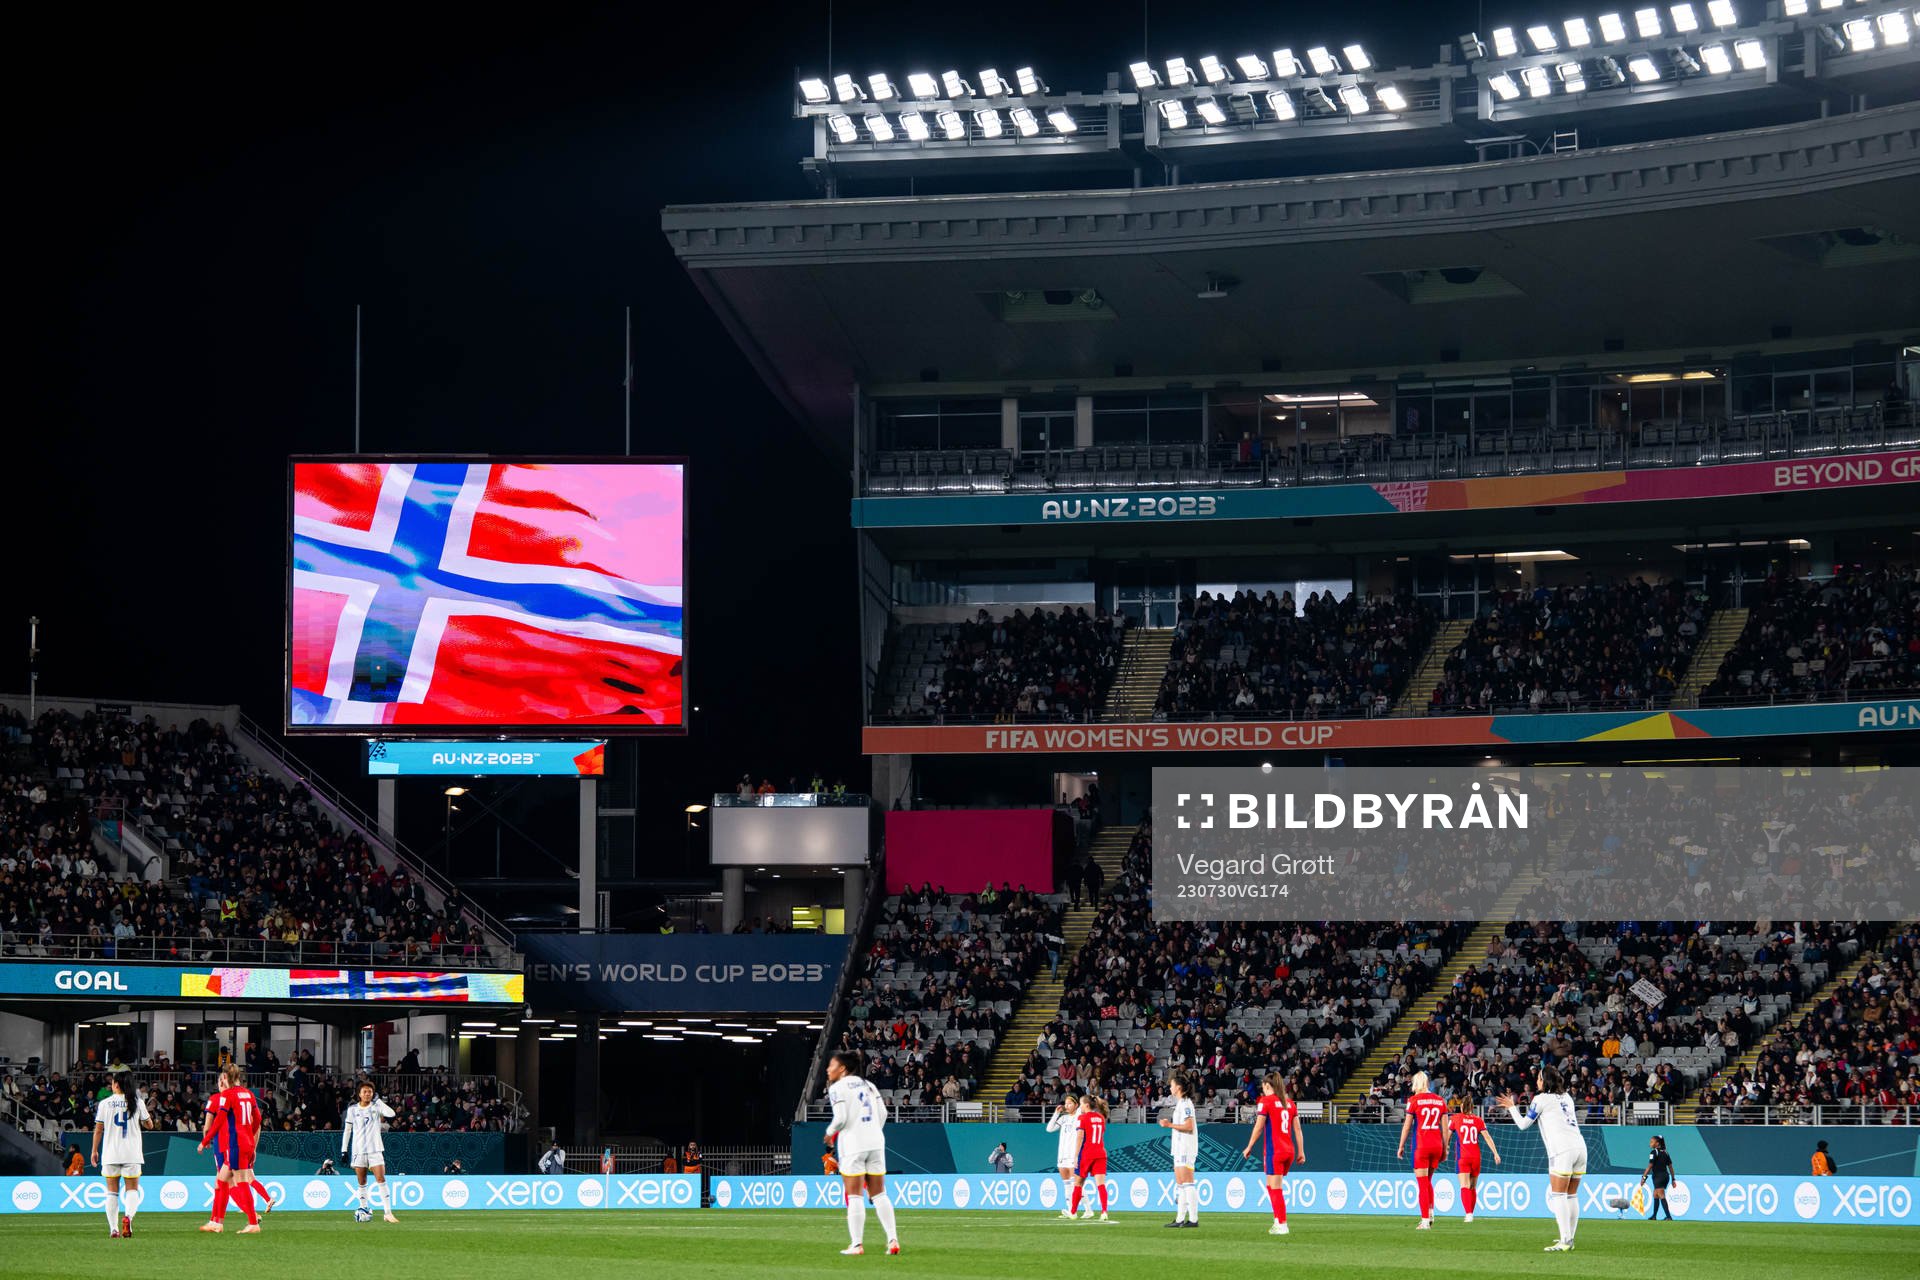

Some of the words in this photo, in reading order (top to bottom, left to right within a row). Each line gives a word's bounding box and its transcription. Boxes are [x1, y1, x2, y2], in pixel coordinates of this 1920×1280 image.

[1775, 460, 1882, 486] BEYOND
[986, 730, 1039, 749] FIFA
[1044, 728, 1169, 748] WOMEN'S
[1177, 727, 1272, 747] WORLD
[54, 970, 128, 990] GOAL
[599, 963, 687, 983] WORLD
[696, 963, 744, 983] CUP
[114, 1111, 128, 1139] 4
[1281, 1109, 1289, 1134] 8
[1421, 1107, 1440, 1130] 22
[1092, 1124, 1102, 1144] 11
[1460, 1125, 1478, 1145] 20
[486, 1180, 563, 1206] xero
[617, 1180, 692, 1205] xero
[740, 1181, 784, 1206] xero
[894, 1180, 942, 1206] xero
[980, 1179, 1031, 1206] xero
[1358, 1180, 1420, 1209] xero
[1703, 1183, 1779, 1216] xero
[1832, 1184, 1912, 1218] xero
